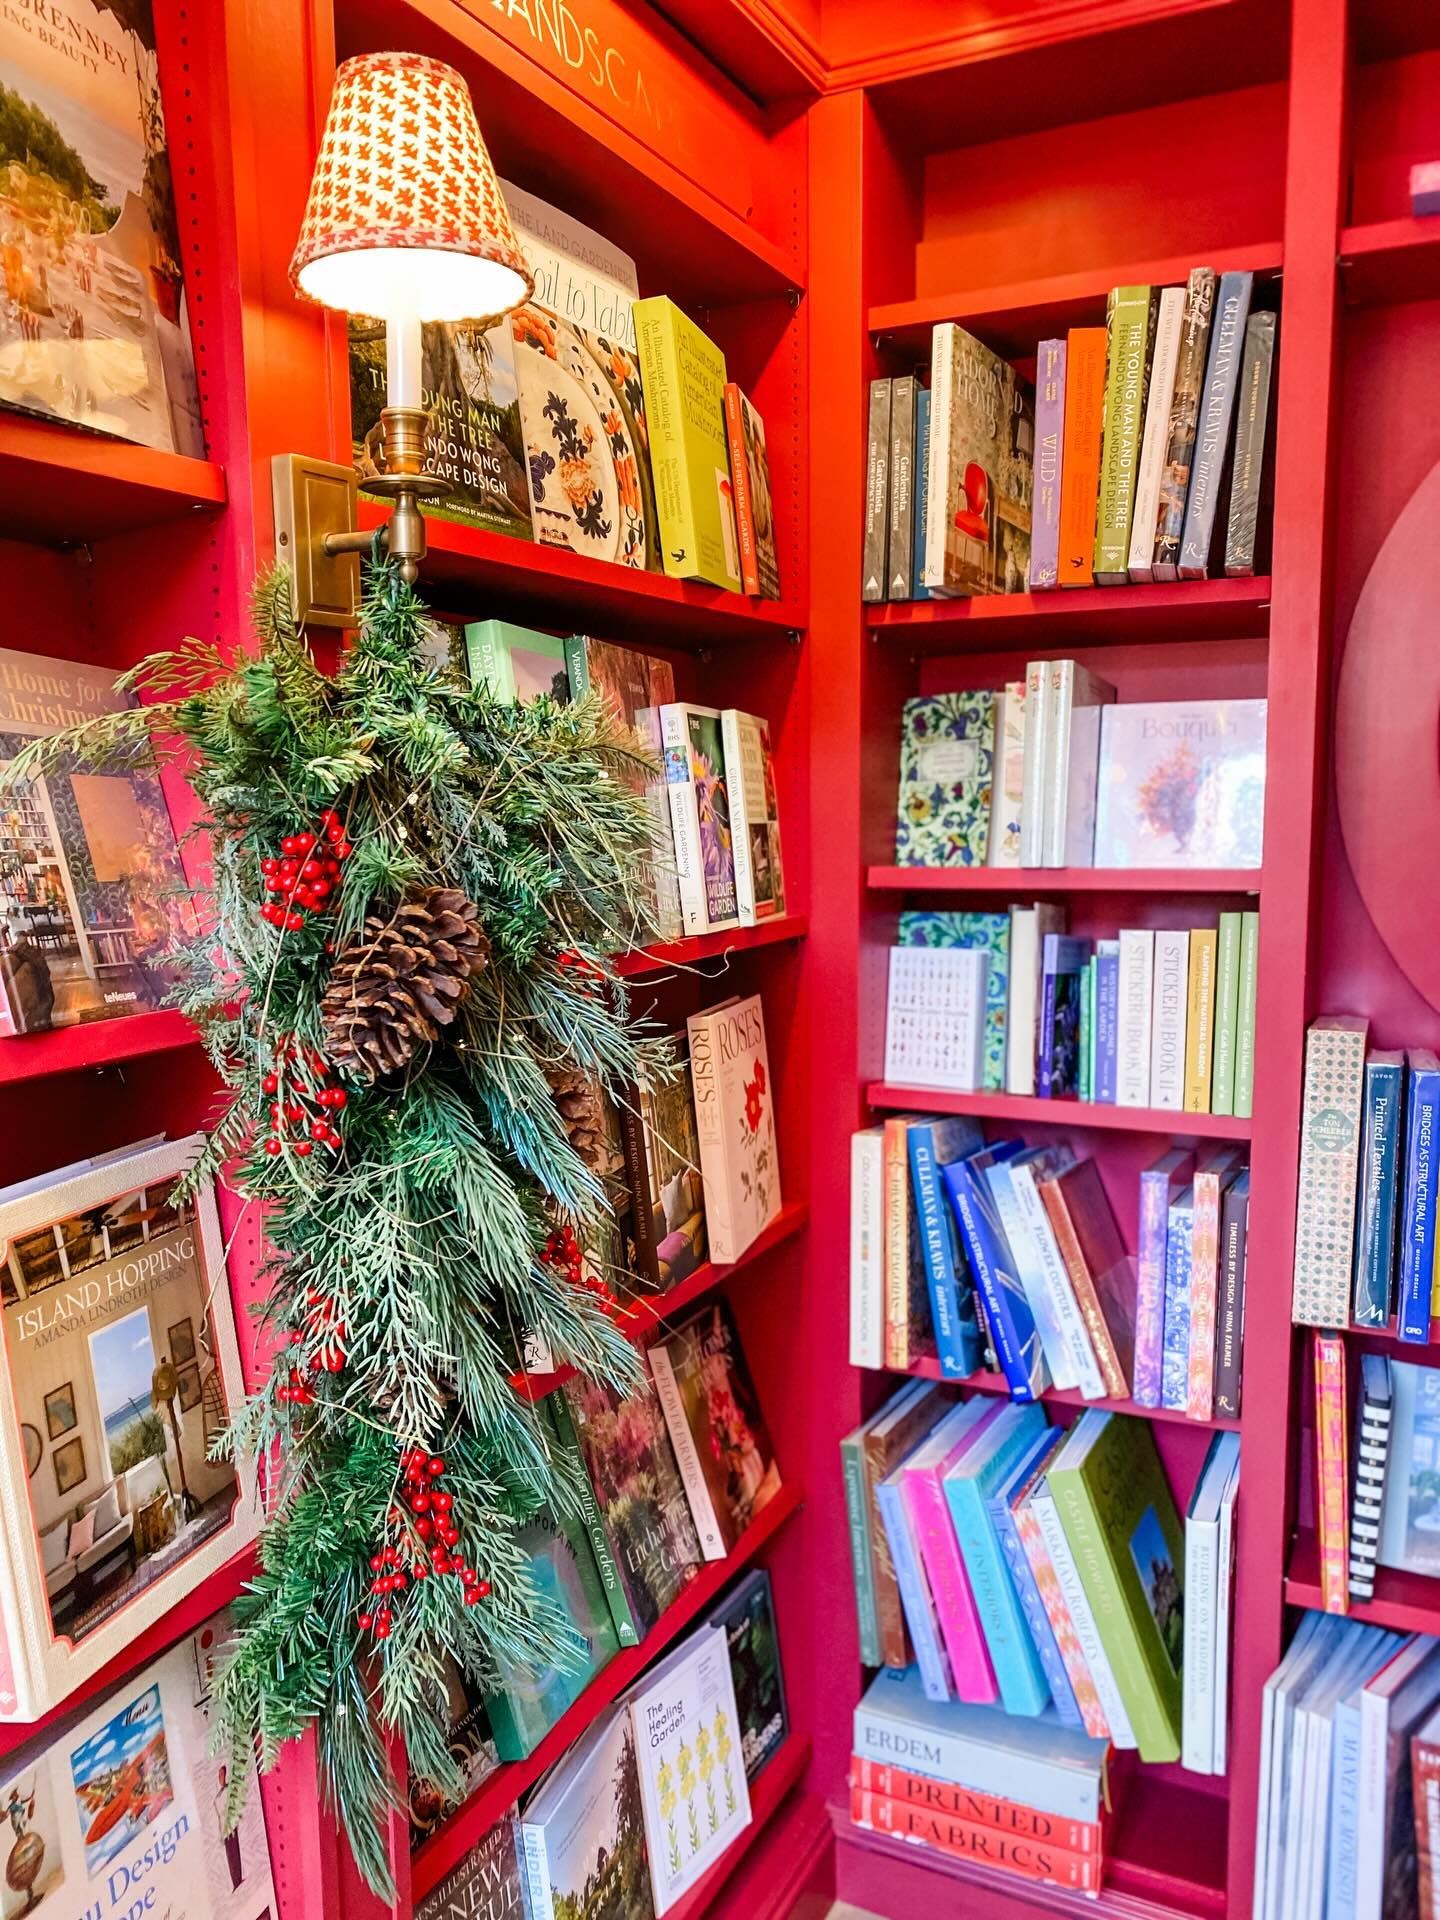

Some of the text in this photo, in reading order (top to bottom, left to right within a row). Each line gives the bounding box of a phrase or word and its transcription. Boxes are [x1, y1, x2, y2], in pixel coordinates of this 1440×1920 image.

[39, 26, 98, 73] BEAUTY
[510, 203, 531, 234] THE
[536, 219, 568, 250] LAND
[521, 245, 560, 309] oil
[566, 277, 585, 322] to
[1130, 323, 1142, 347] THE
[641, 321, 660, 429] American Mushrooms
[651, 319, 674, 442] An Illustrated Catalog of
[1125, 350, 1140, 399] YOUNG
[430, 413, 456, 437] THE
[460, 422, 493, 450] TREE
[467, 406, 501, 432] MAN
[1105, 324, 1129, 529] FERNANDO WONG LANDSCAPE DESIGN
[1123, 404, 1137, 437] MAN
[1193, 297, 1239, 519] CULLMAN & KRAVIS interiors
[460, 446, 501, 474] WONG
[733, 448, 743, 484] SELF-FED
[1040, 434, 1057, 482] WILD
[1119, 441, 1133, 468] AND
[463, 468, 507, 496] DESIGN
[737, 486, 745, 509] FARM
[874, 459, 886, 514] Gardenista
[899, 457, 910, 512] Gardenista
[1118, 472, 1131, 497] THE
[446, 502, 511, 525] FOREWORD BY MARTHA STEWART
[742, 519, 751, 555] GARDEN
[1115, 499, 1128, 529] TREE
[1, 664, 103, 706] Home for
[572, 651, 584, 691] VERANDA
[0, 692, 107, 727] Christma
[675, 791, 691, 879] WILDLIFE GARDENING
[707, 881, 735, 899] WILDLIFE
[709, 899, 736, 917] GARDEN
[104, 990, 137, 1004] teNeues
[1126, 945, 1145, 1071] STICKER BOOK
[1160, 946, 1179, 1075] STICKER BOOK
[1198, 945, 1210, 1077] PLANTING THE NATURAL GARDEN
[717, 1006, 762, 1064] ROSES
[691, 1028, 716, 1103] ROSES
[628, 1126, 635, 1139] BY
[1374, 1097, 1388, 1141] Printed
[630, 1140, 639, 1173] DESIGN
[1371, 1144, 1386, 1191] Textiles
[1414, 1105, 1432, 1243] BRIDGES AS STRUCTURAL ART
[639, 1203, 647, 1240] FARMER
[957, 1193, 975, 1230] BRIDGES
[916, 1147, 952, 1337] CULLMAN & KRAVIS interiors
[968, 1230, 978, 1244] AS
[17, 1237, 194, 1341] ISLAND HOPPING
[972, 1243, 993, 1298] STRUCTURAL
[1034, 1226, 1073, 1320] FLOWER COUTURE
[34, 1266, 188, 1350] AMANDA LINDROTH DESIGN
[988, 1295, 1001, 1314] ART
[1224, 1222, 1238, 1367] TIMELESS BY DESIGN NINA FARMER
[656, 1361, 699, 1489] the FLOWER FARMERS
[592, 1527, 617, 1590] Gardens
[1063, 1489, 1113, 1614] CASTLE HOWARD
[1040, 1508, 1099, 1661] MARKHAM ROBERTS
[1200, 1546, 1209, 1693] BUILDING ON TRADITION
[122, 1700, 151, 1729] Menu
[646, 1702, 663, 1721] The
[649, 1700, 682, 1735] Healing
[651, 1713, 686, 1748] Garden
[865, 1727, 941, 1764] ERDEM
[1341, 1736, 1357, 1800] MANET
[908, 1779, 1053, 1838] PRINTED
[107, 1814, 190, 1907] Design
[525, 1829, 544, 1896] UNDER
[908, 1813, 1053, 1874] FABRICS
[1336, 1826, 1355, 1906] MORISOT
[448, 1848, 503, 1919] NEW
